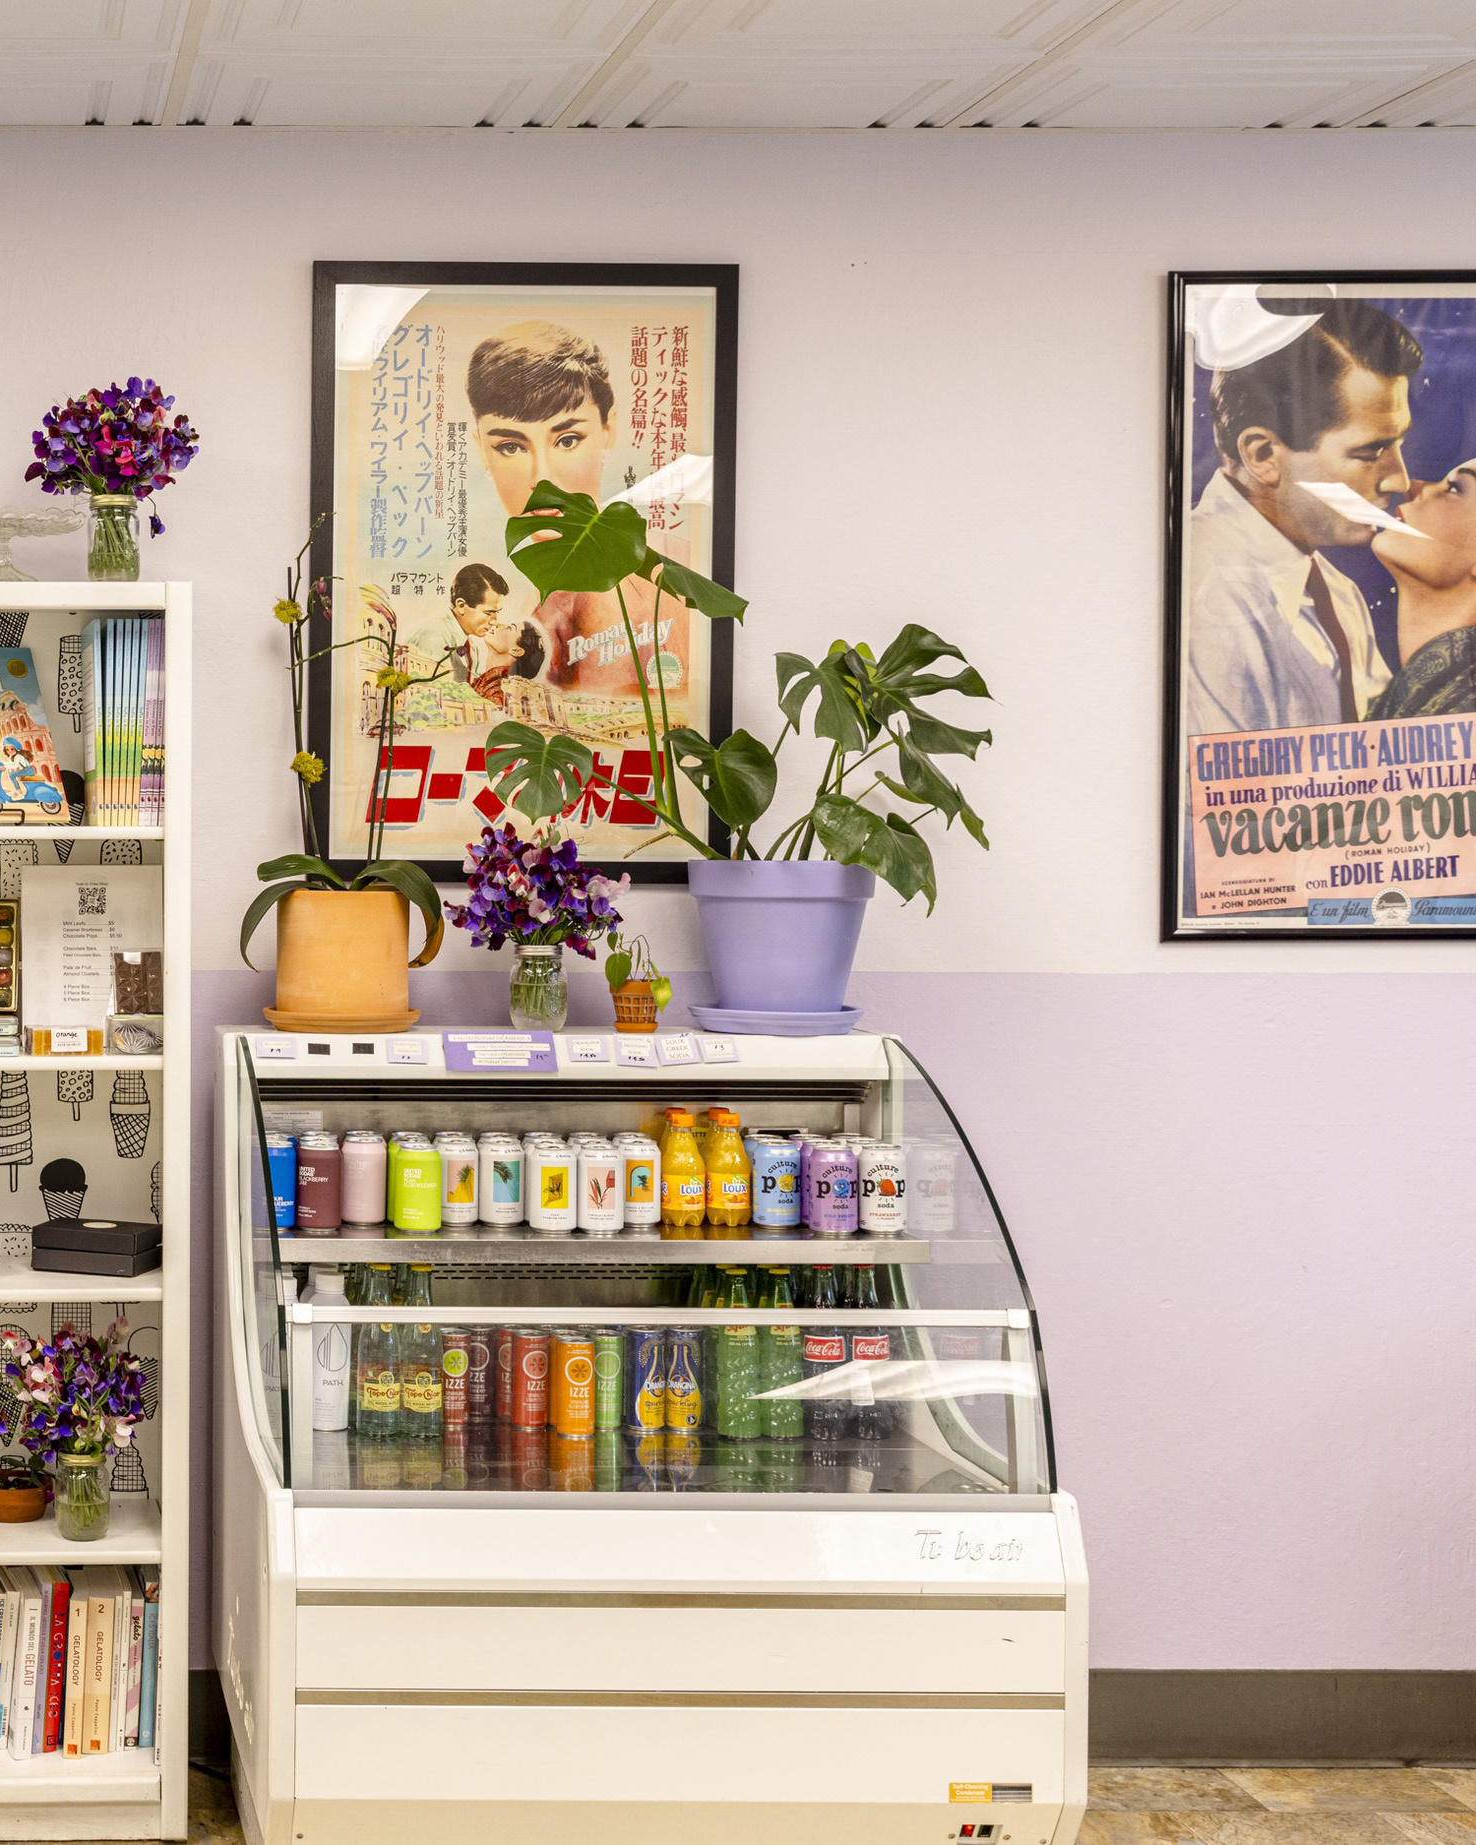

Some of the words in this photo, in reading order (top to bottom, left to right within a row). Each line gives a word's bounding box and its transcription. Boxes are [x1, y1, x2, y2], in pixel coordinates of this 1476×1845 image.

[1196, 735, 1304, 782] GREGORY
[1310, 730, 1368, 772] PECK
[1377, 720, 1474, 767] AUDREY
[1205, 786, 1226, 807] in
[1230, 787, 1268, 804] una
[1272, 775, 1378, 806] produzione
[1383, 770, 1402, 792] di
[1406, 763, 1476, 790] WILLIA
[1199, 797, 1392, 858] vacanze
[1330, 862, 1384, 888] EDDIE
[1390, 855, 1460, 883] ALBERT
[1305, 878, 1328, 890] con
[1200, 889, 1216, 899] IAN
[1264, 885, 1296, 895] HUNTER
[1220, 900, 1244, 909] JOHN
[1247, 897, 1287, 908] DIGHTON
[1411, 899, 1476, 917] Paramoun
[768, 1161, 797, 1174] culture
[822, 1165, 853, 1178] culture
[867, 1164, 899, 1177] culture
[445, 1379, 465, 1389] IZZE
[527, 1381, 545, 1391] IZZE
[597, 1381, 617, 1390] IZZE
[569, 1387, 589, 1398] IZZE
[75, 1608, 80, 1617] 1
[98, 1604, 105, 1614] 2
[132, 1616, 141, 1641] gelato
[72, 1635, 81, 1686] GELATOLOGY
[95, 1631, 104, 1682] GELATOLOGY
[24, 1654, 36, 1686] GELATO
